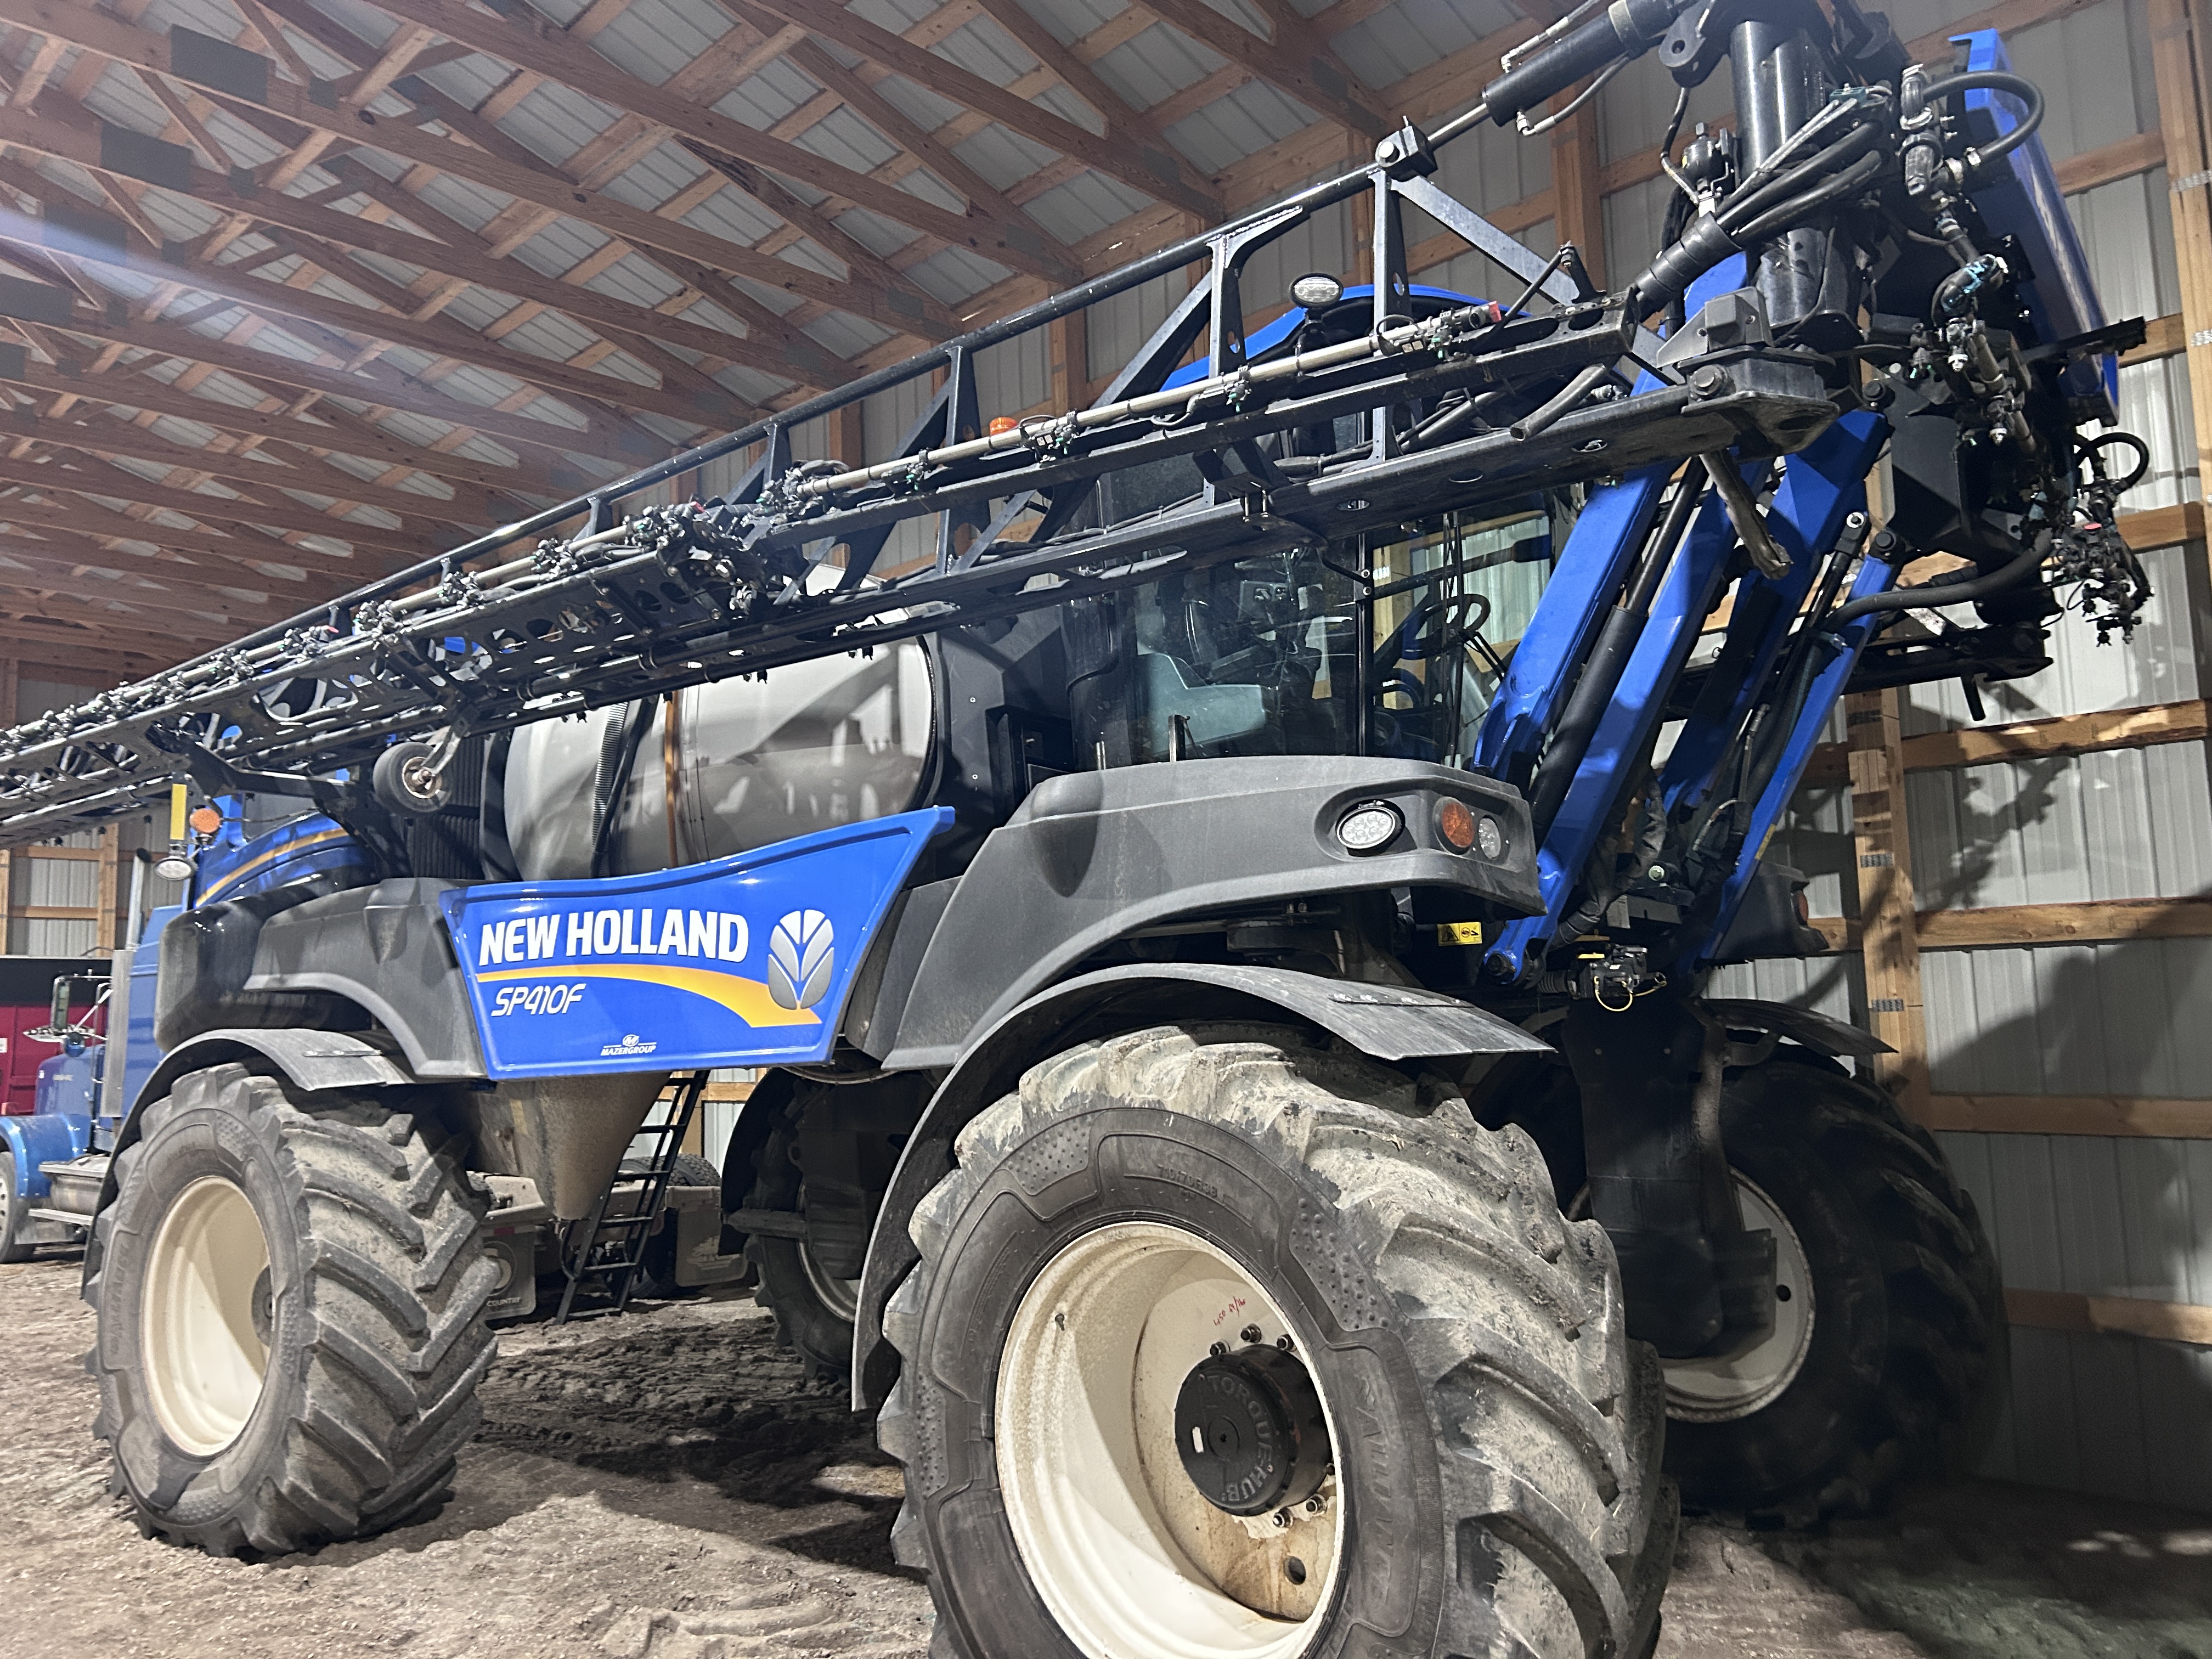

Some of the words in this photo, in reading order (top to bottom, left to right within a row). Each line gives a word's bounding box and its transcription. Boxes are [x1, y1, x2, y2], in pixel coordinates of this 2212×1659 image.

[479, 914, 561, 966] NEW
[566, 909, 749, 963] HOLLAND
[491, 983, 586, 1017] SP410F
[600, 1045, 657, 1056] MAZERGROUP
[1213, 1310, 1226, 1326] 450
